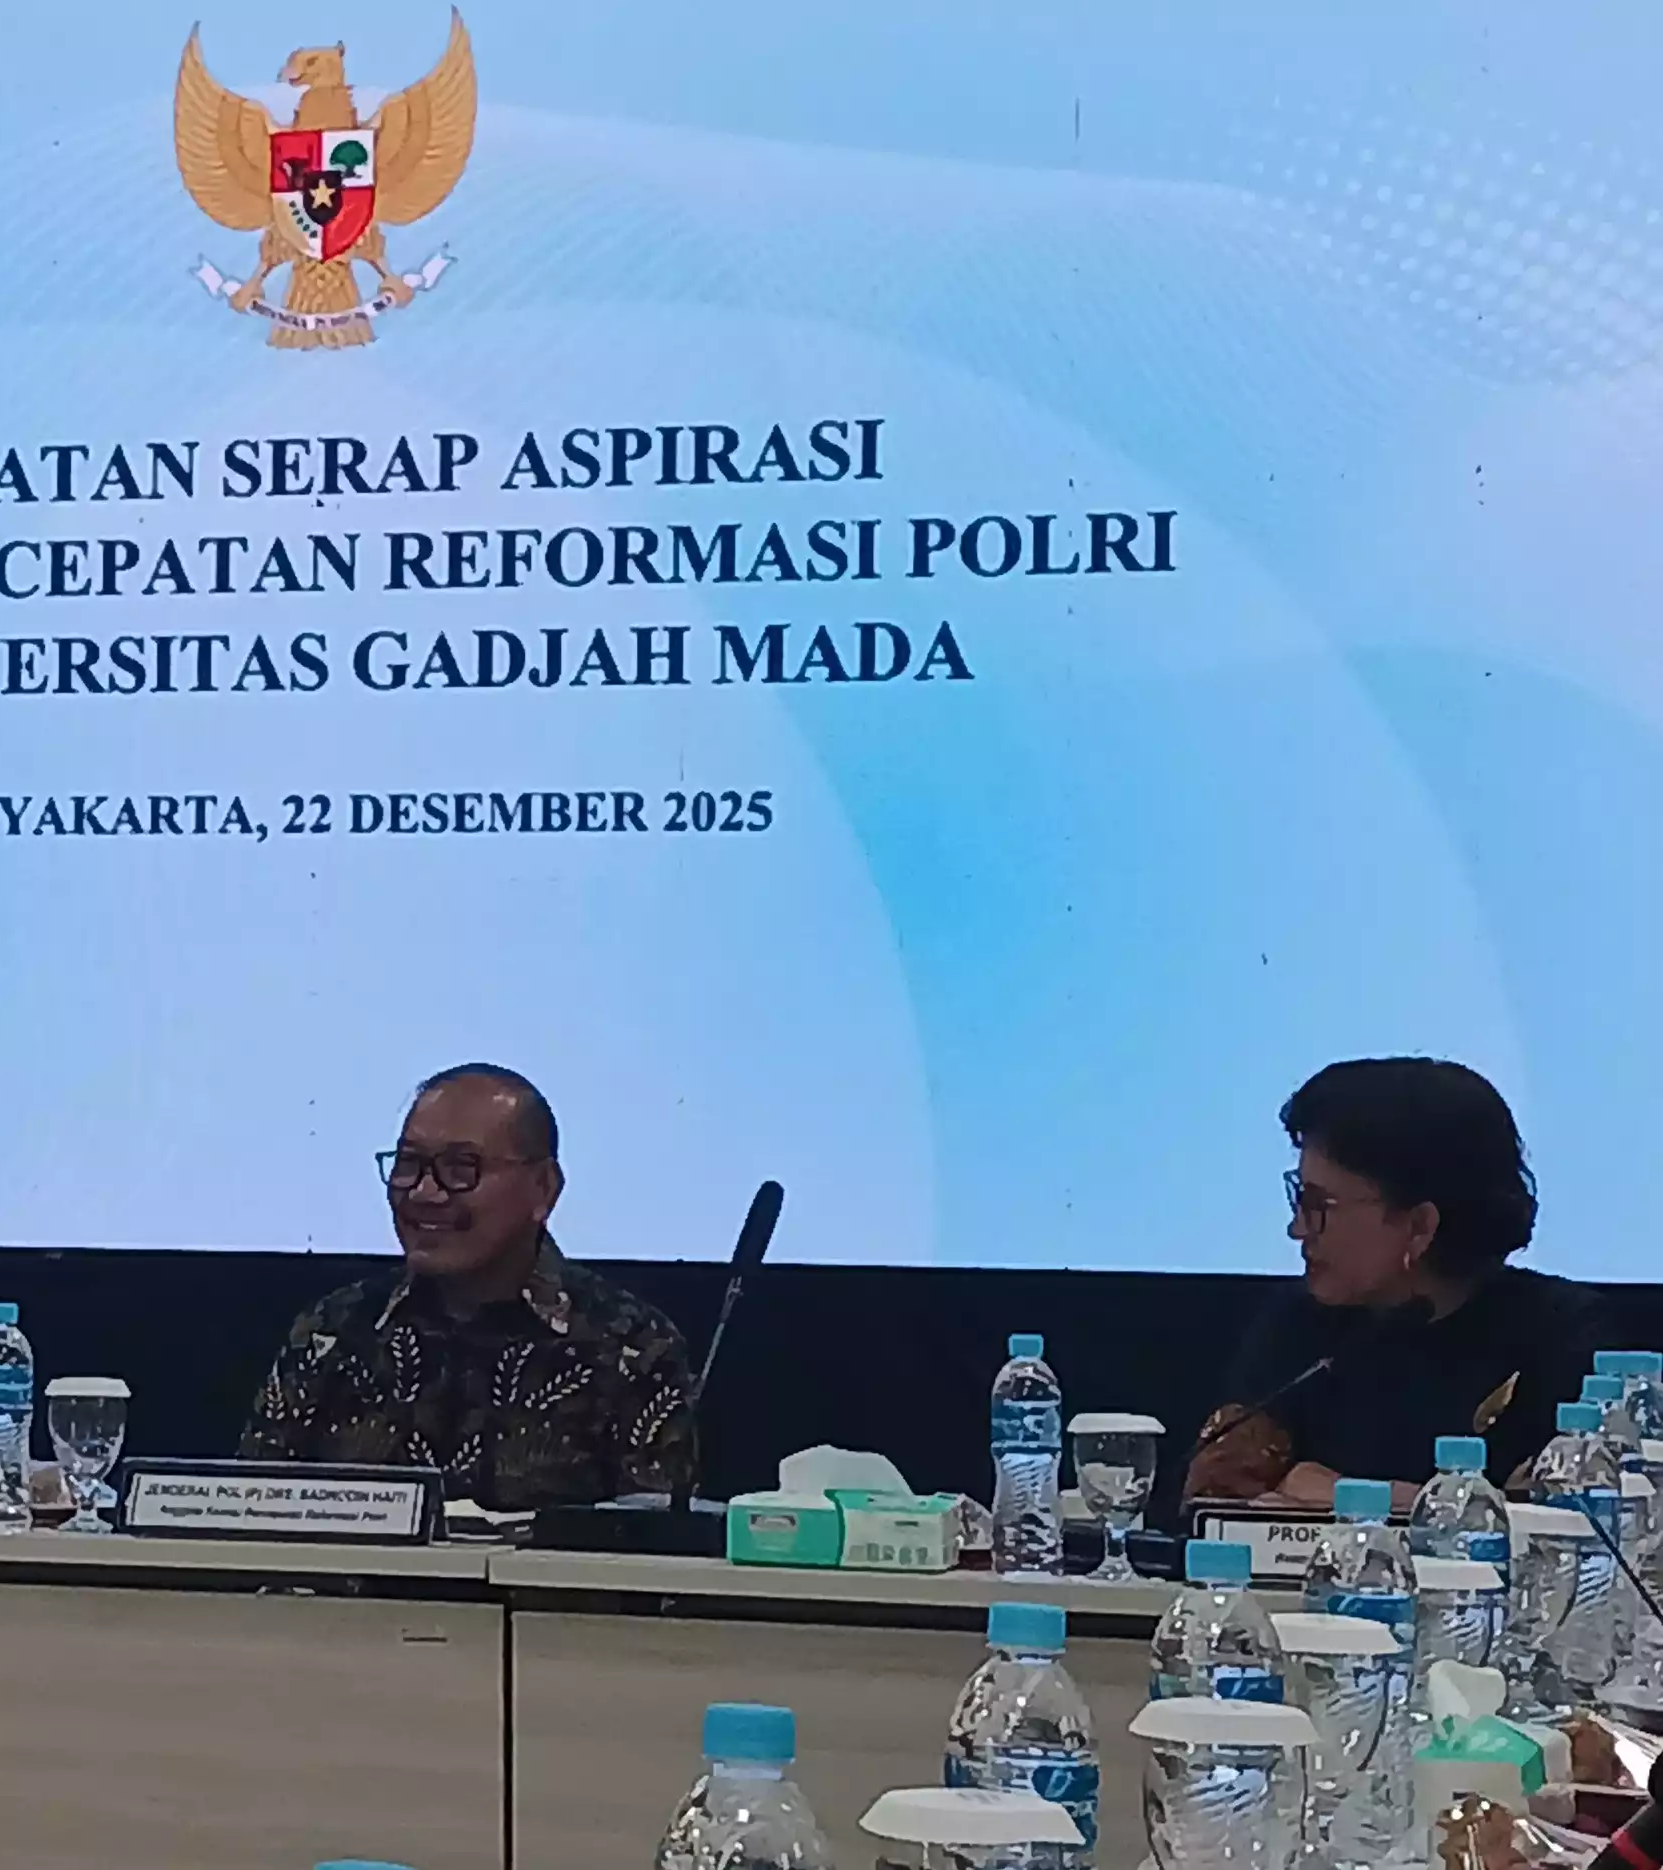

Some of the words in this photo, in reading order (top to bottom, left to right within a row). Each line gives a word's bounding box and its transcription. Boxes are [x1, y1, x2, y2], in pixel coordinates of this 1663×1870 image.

[222, 432, 478, 499] SERAP
[501, 418, 884, 489] ASPIRASI
[384, 518, 882, 590] REFORMASI
[906, 510, 1178, 578] POLRI
[354, 626, 691, 691] GADJAH
[712, 620, 975, 685] MADA
[282, 794, 331, 834] 22
[349, 791, 649, 834] DESEMBER
[663, 790, 773, 832] 2025
